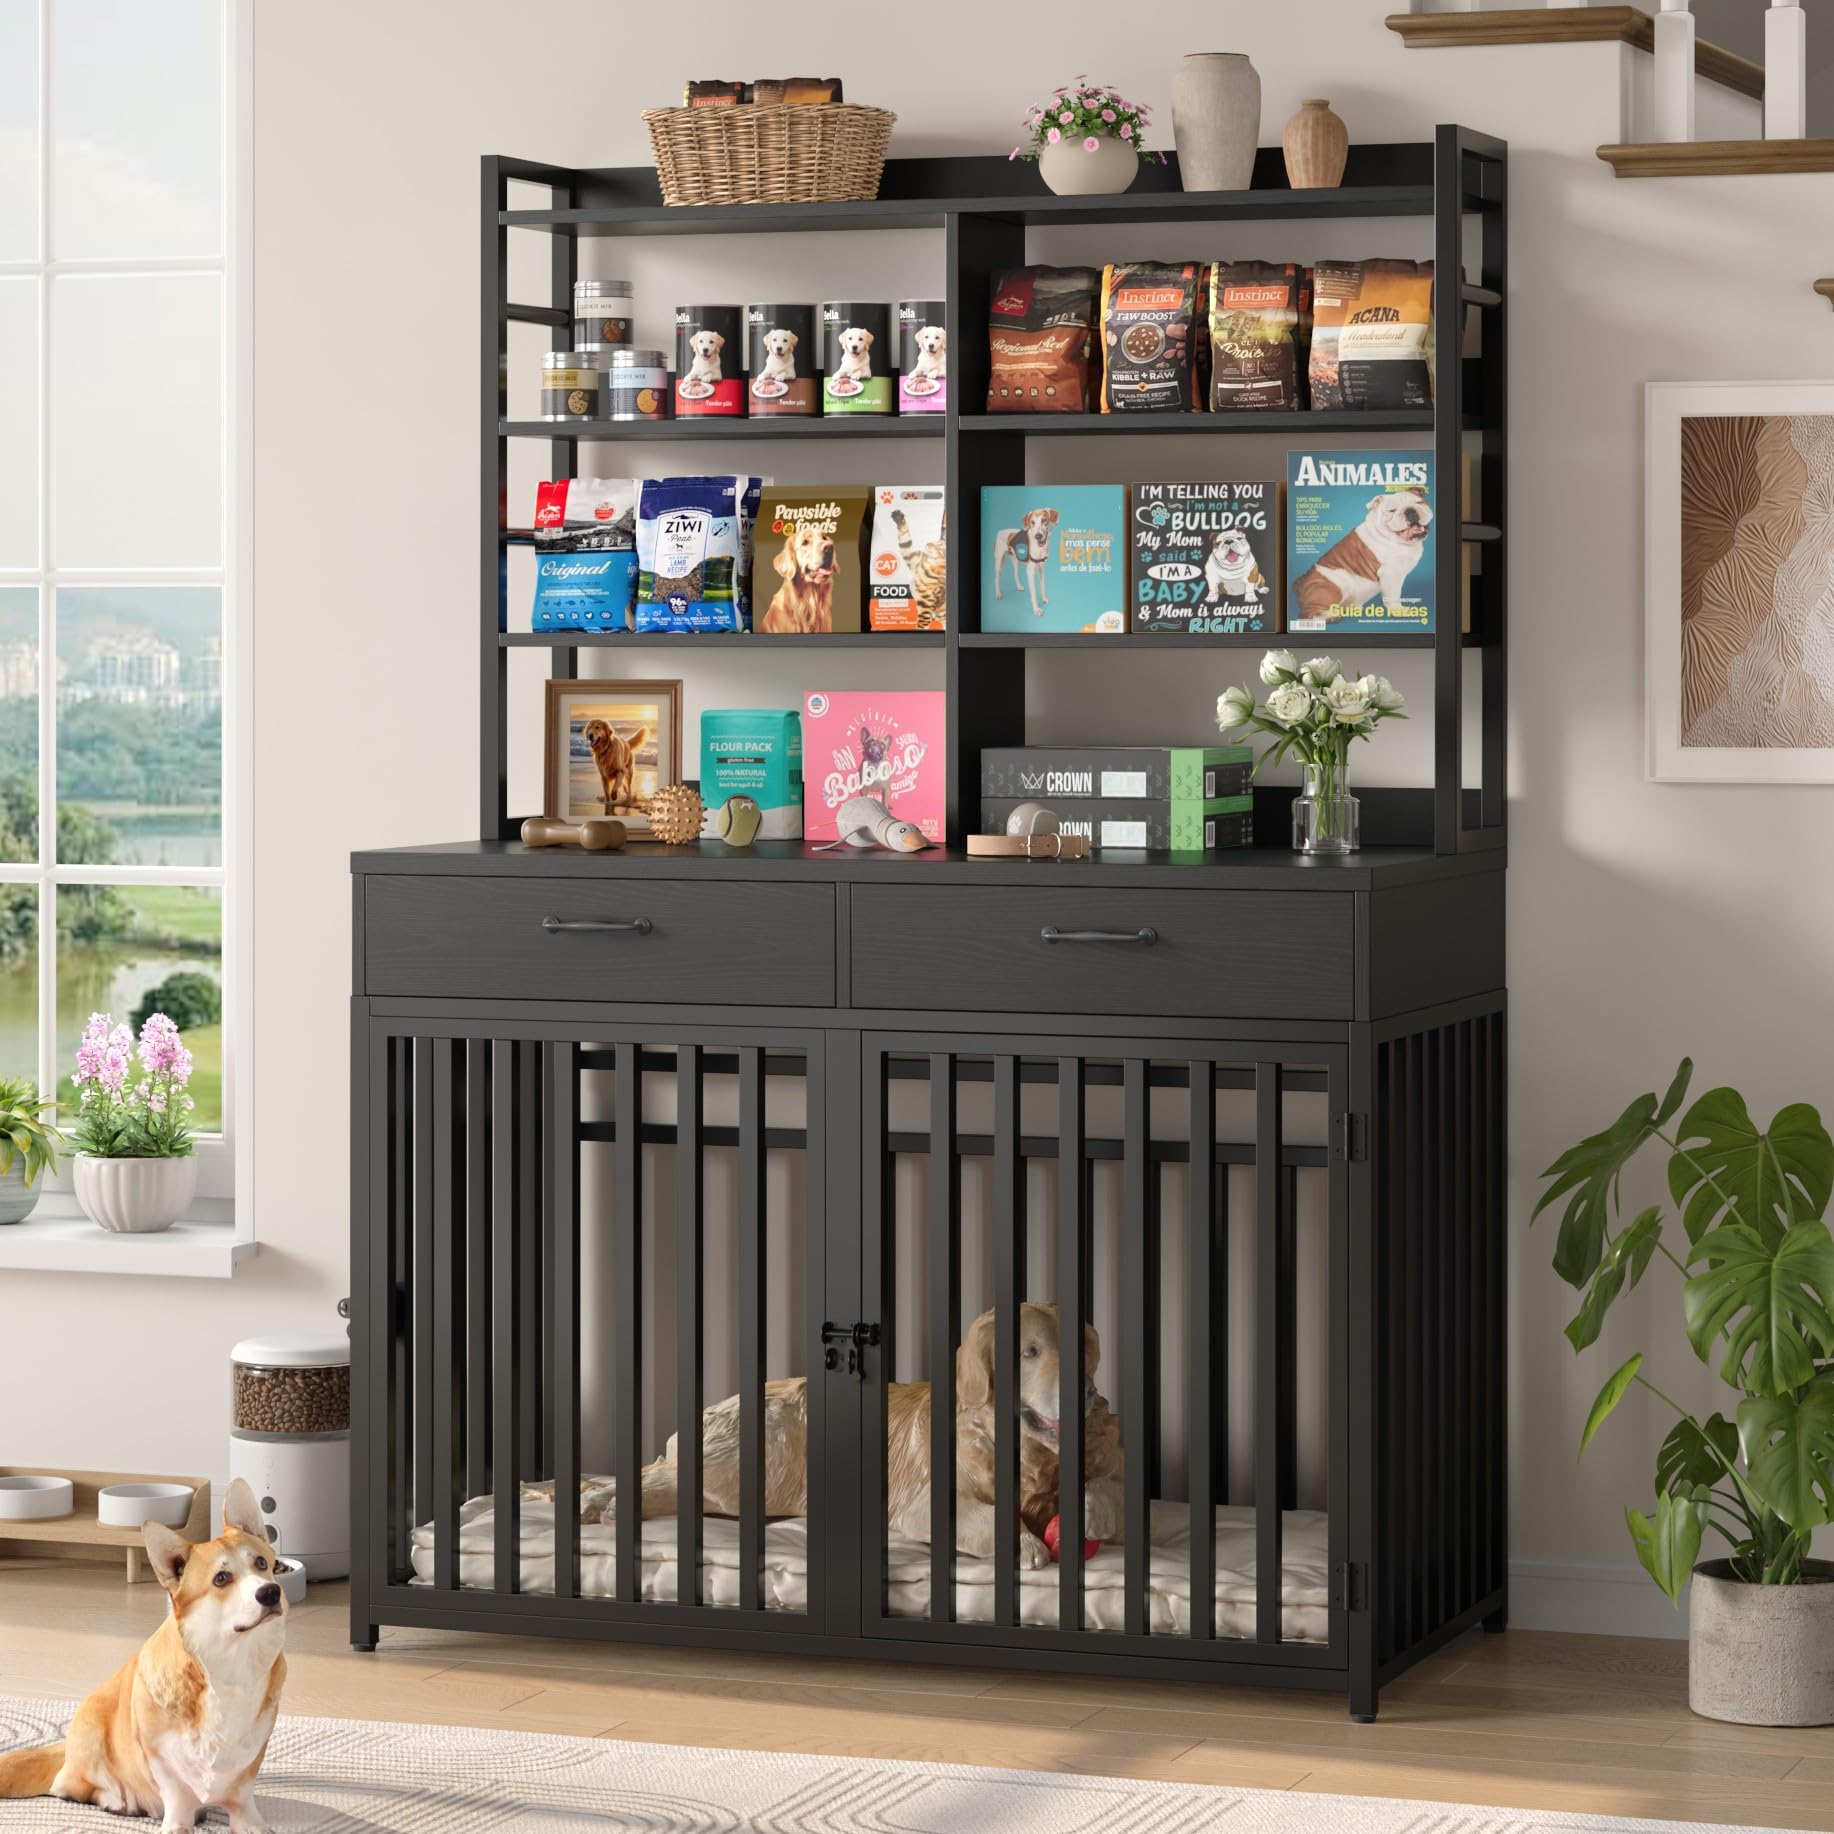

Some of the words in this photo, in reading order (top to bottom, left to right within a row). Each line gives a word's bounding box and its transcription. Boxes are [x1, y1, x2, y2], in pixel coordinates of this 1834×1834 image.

[1123, 291, 1176, 304] Instinct
[1229, 288, 1283, 302] Instinct
[1349, 306, 1400, 324] ACANA
[1149, 371, 1176, 380] RAW
[1294, 456, 1428, 486] ANIMALES
[1141, 485, 1162, 499] I'M
[1167, 484, 1228, 499] TELLING
[1233, 484, 1264, 498] YOU
[774, 502, 842, 520] Pawsible
[1186, 501, 1205, 510] I'm
[1208, 500, 1228, 510] not
[664, 520, 702, 534] ZIWI
[794, 518, 838, 534] foods
[1172, 511, 1266, 530] BULLDOG
[1136, 531, 1162, 550] My
[1166, 531, 1203, 548] Mom
[1159, 551, 1187, 562] said
[541, 560, 612, 580] Original
[875, 560, 897, 570] CAT
[1160, 566, 1180, 578] I'M
[1184, 566, 1192, 576] A
[874, 586, 908, 596] FOOD
[1138, 578, 1206, 603] BABY
[1138, 604, 1151, 622] &
[1156, 604, 1193, 619] Mom
[1198, 602, 1209, 618] is
[1213, 602, 1264, 618] always
[1365, 604, 1384, 617] de
[1387, 606, 1428, 618] razas
[1188, 618, 1248, 632] RIGHT
[710, 742, 743, 752] FLOUR
[745, 742, 773, 752] PACK
[825, 744, 926, 808] Baboso
[1046, 772, 1092, 792] CROWN
[1059, 821, 1092, 842] OWN
